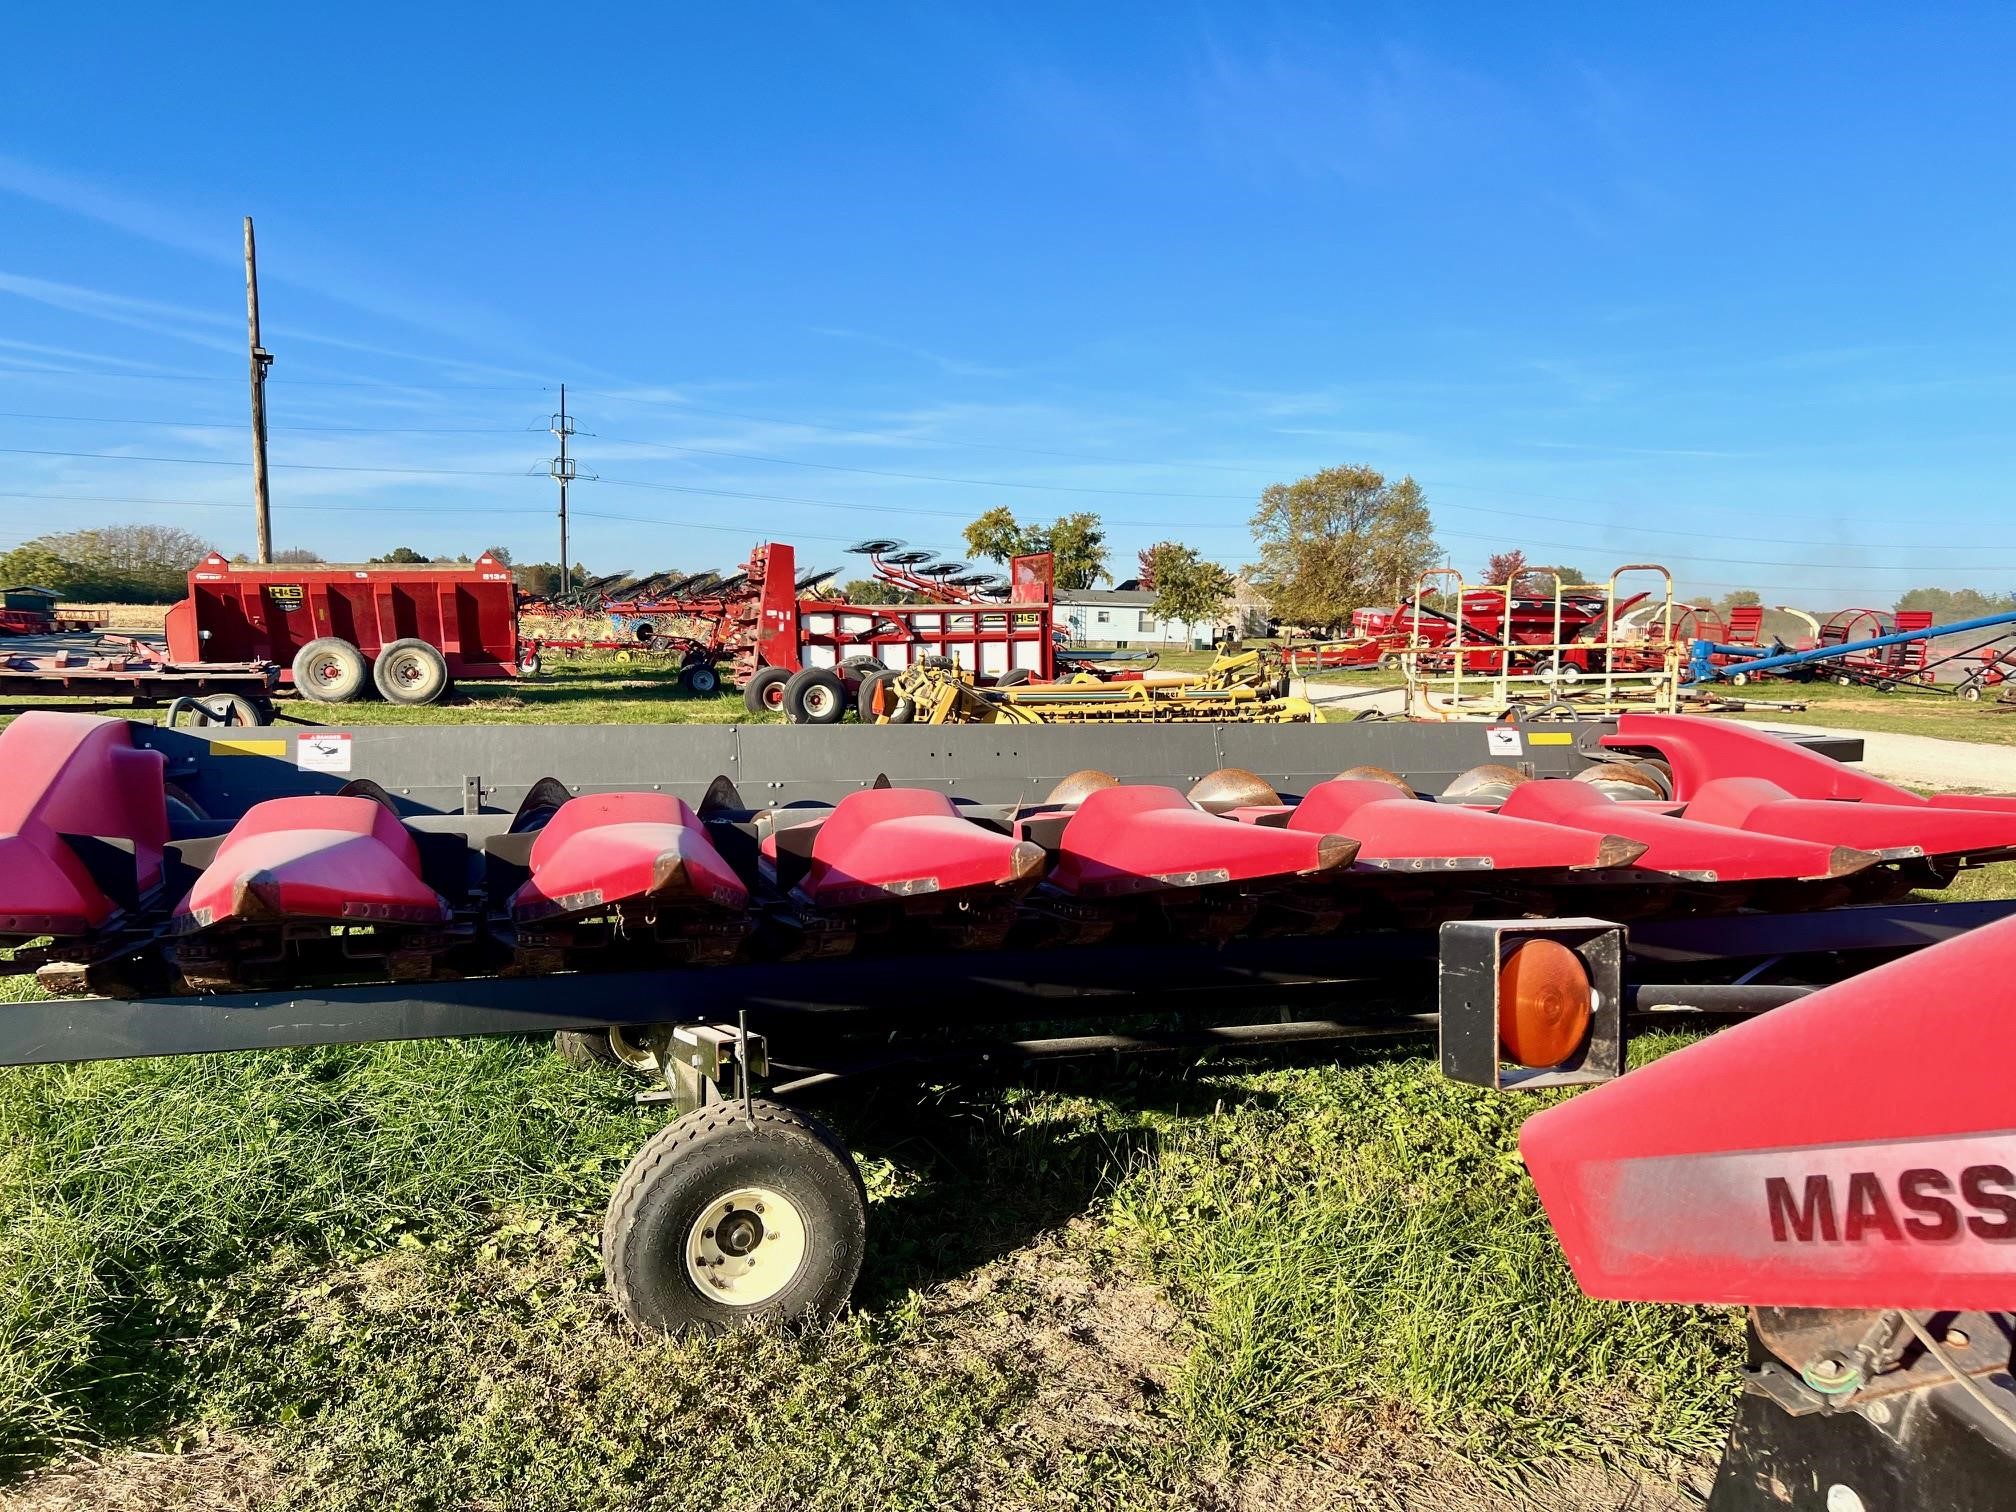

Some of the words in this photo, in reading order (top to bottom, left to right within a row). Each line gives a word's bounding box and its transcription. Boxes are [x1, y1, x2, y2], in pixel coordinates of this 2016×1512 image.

[270, 587, 302, 597] H&S
[1015, 614, 1035, 622] H&S
[672, 1162, 719, 1199] SPECIAL
